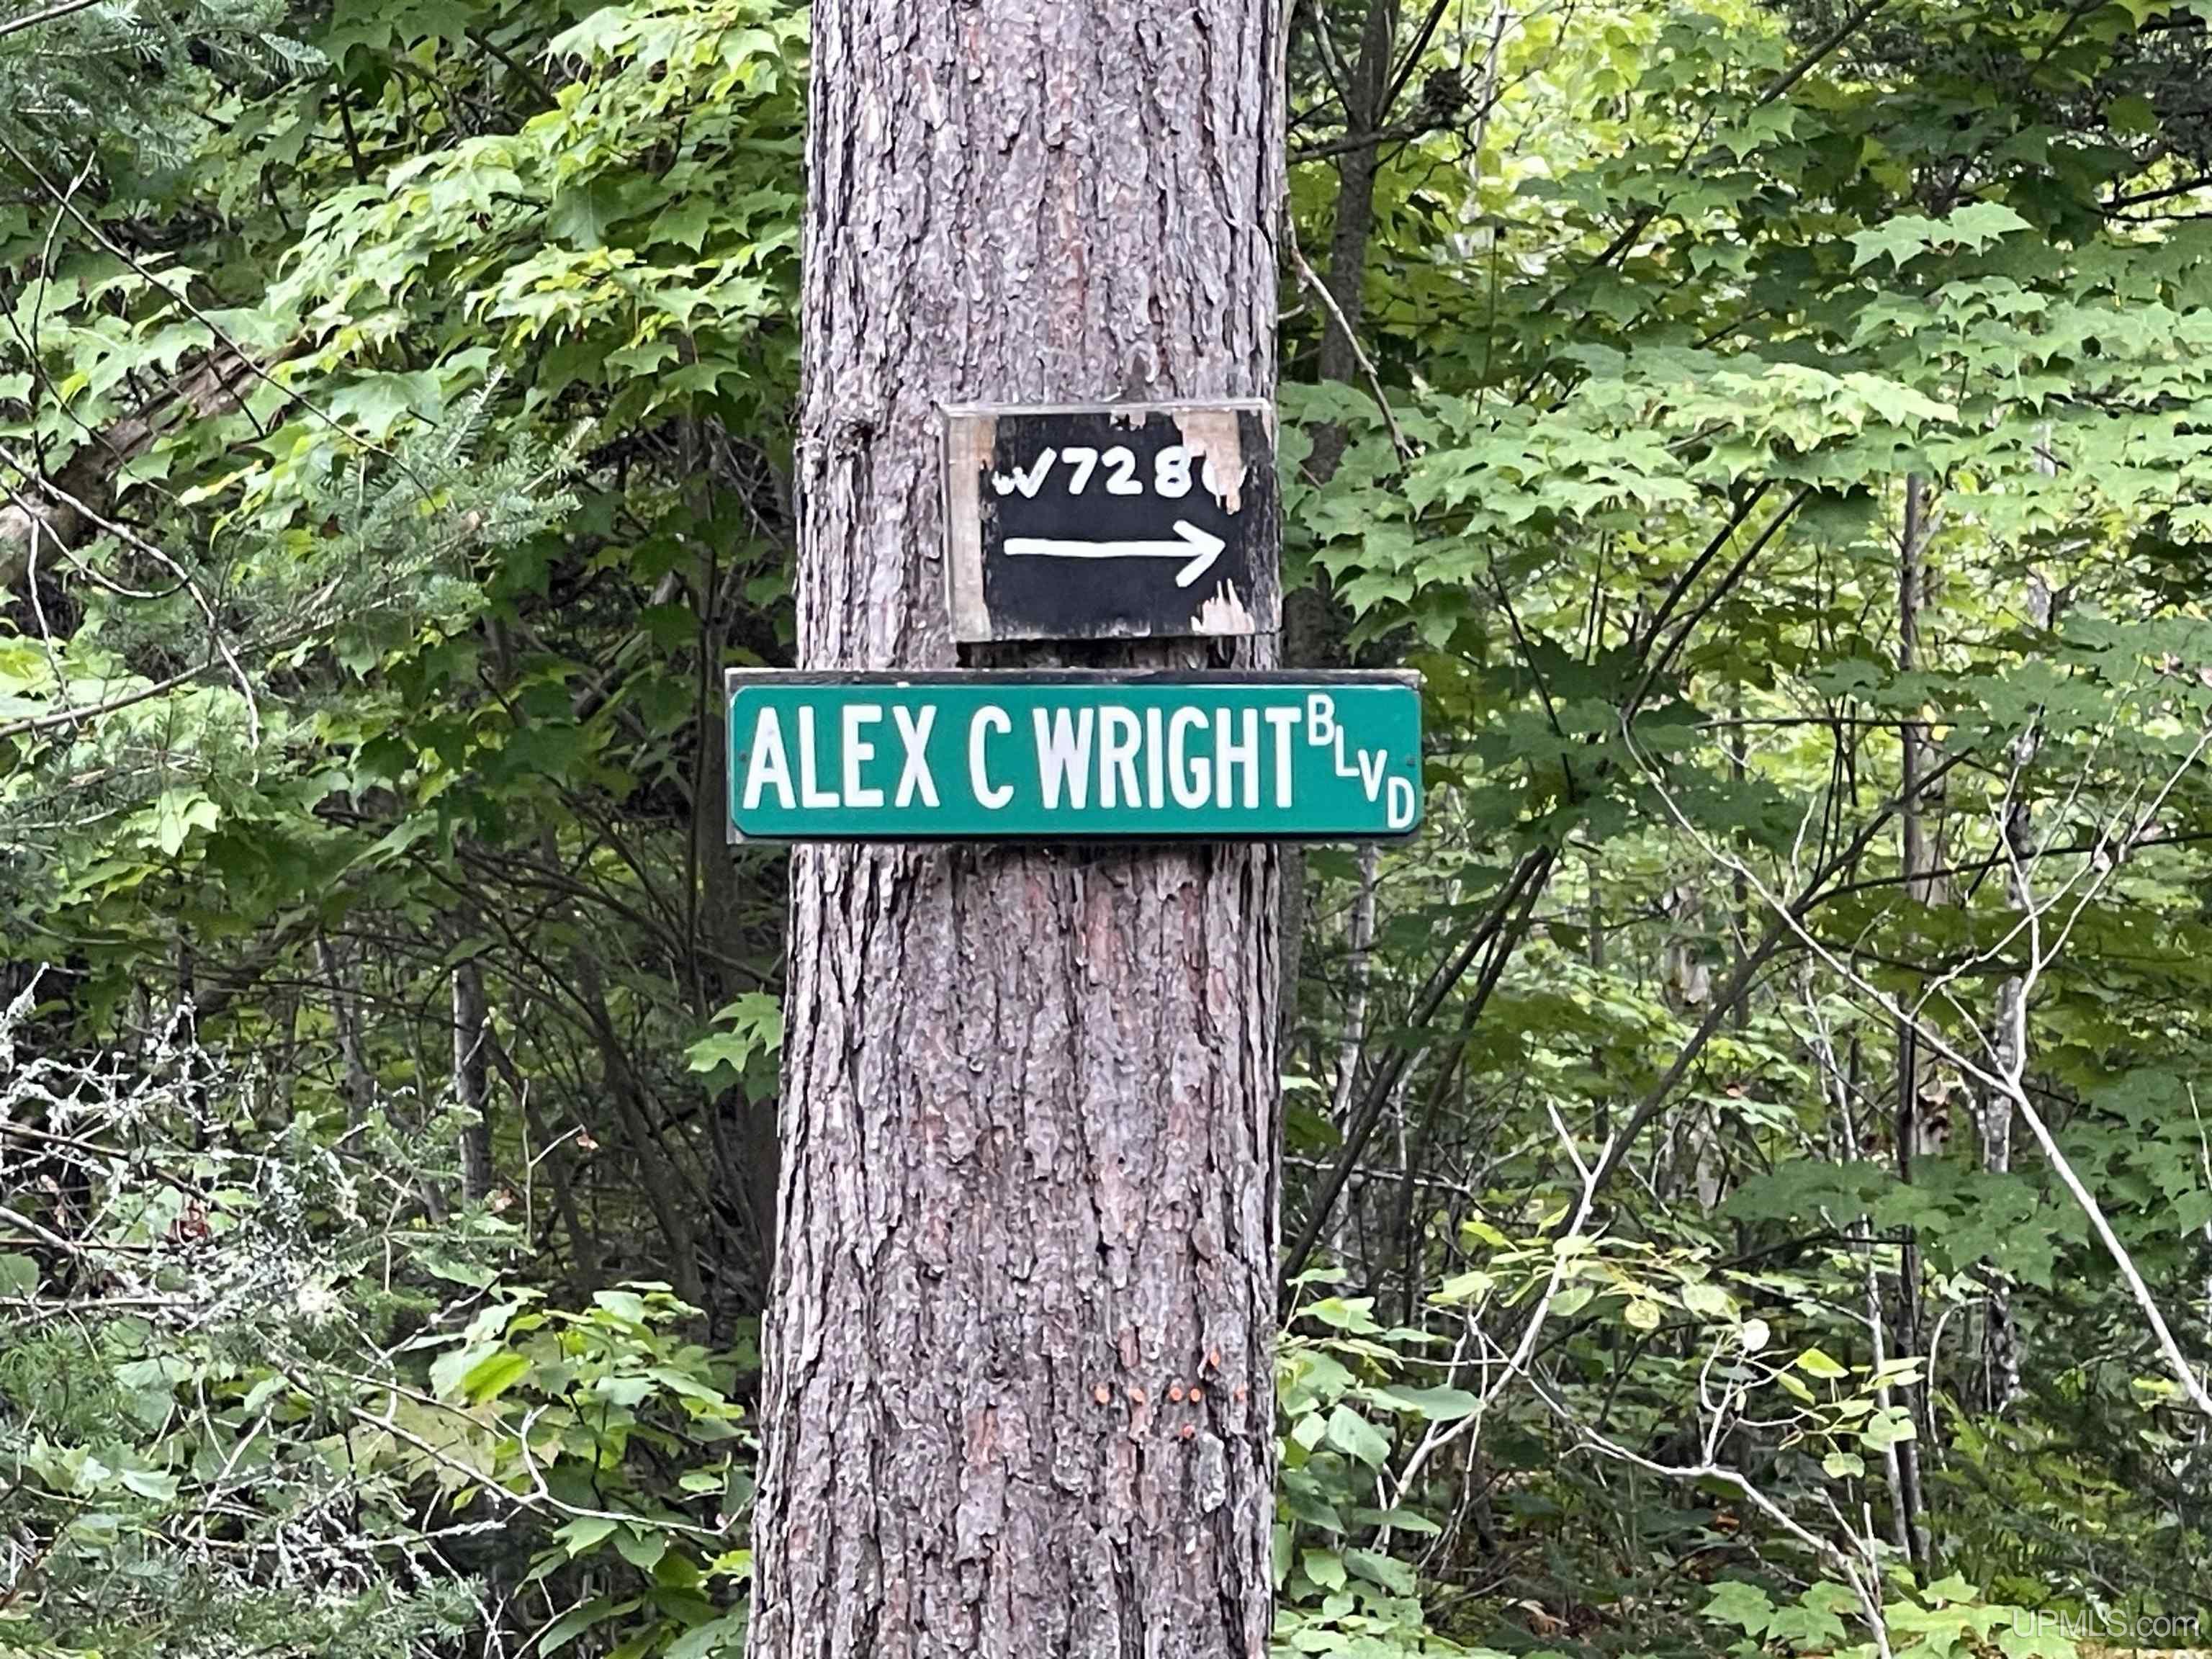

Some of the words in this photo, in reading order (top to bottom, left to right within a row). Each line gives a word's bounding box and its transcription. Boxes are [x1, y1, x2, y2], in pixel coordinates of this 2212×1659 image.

[742, 705, 940, 809] ALEX
[968, 705, 1013, 810] C
[1033, 706, 1301, 810] WRIGHT
[1308, 694, 1416, 828] BLVD
